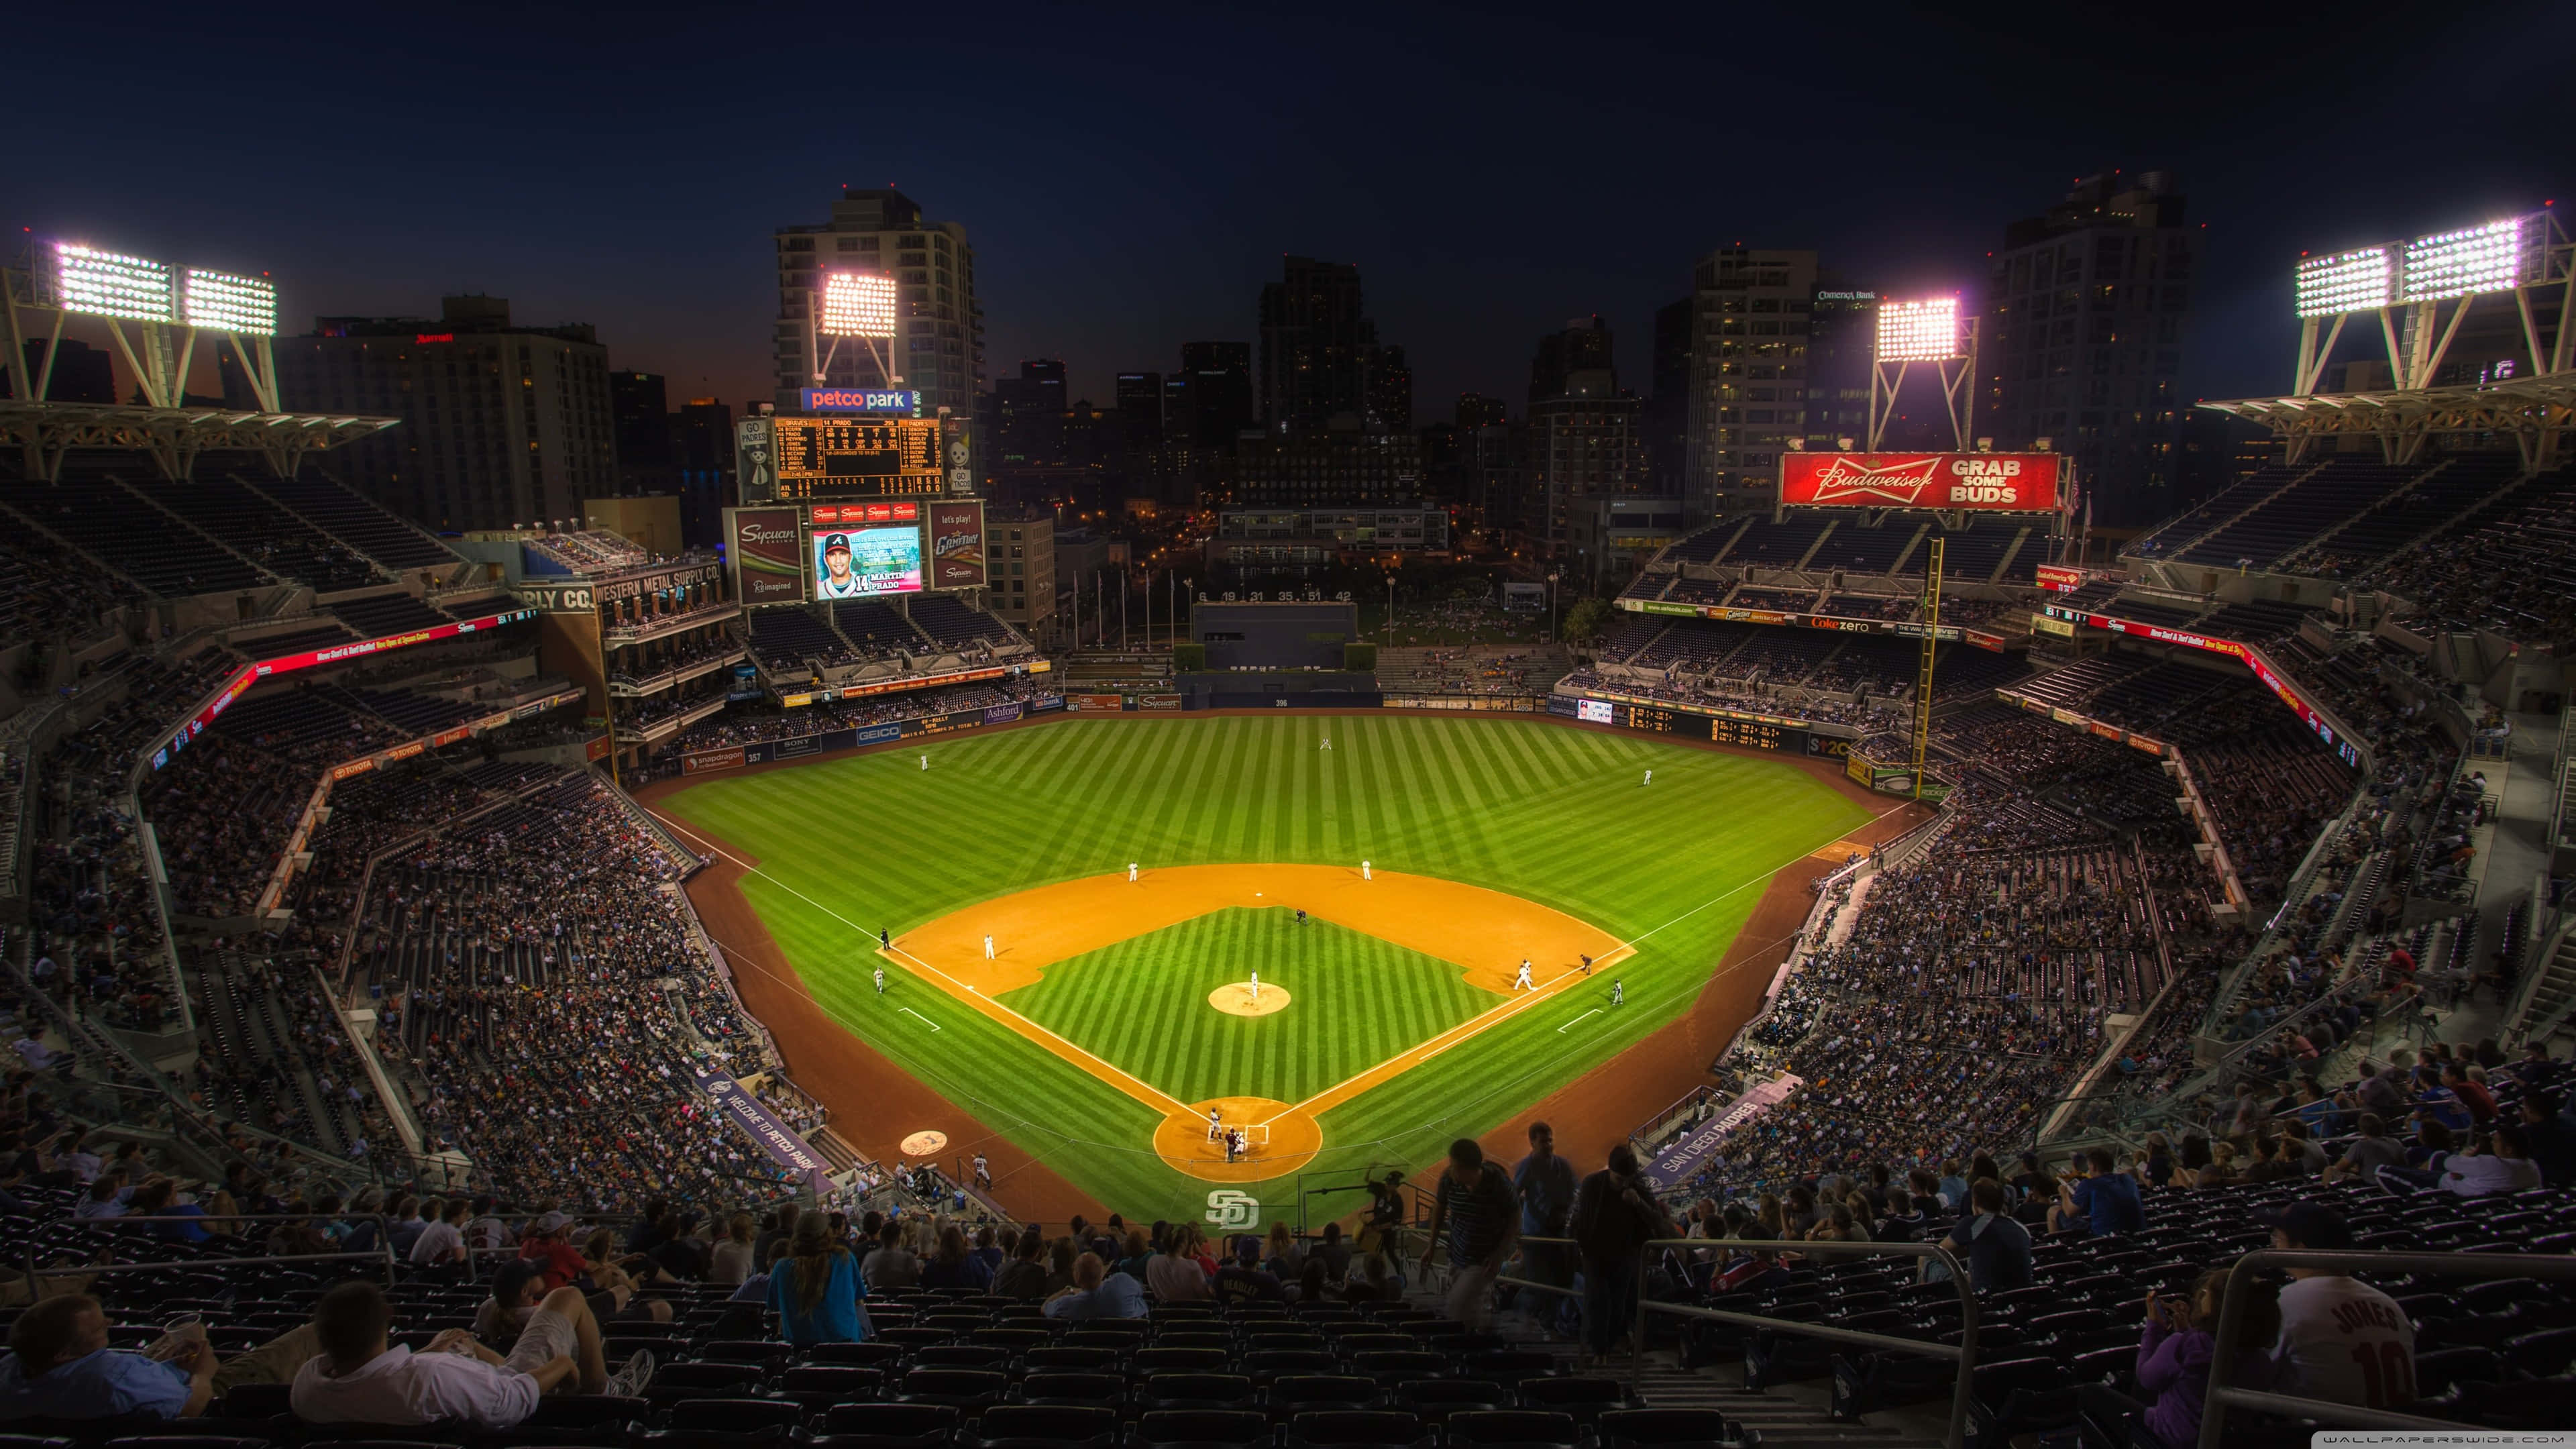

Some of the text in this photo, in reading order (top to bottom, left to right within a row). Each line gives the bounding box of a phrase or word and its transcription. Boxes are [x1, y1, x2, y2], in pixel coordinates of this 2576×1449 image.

[1856, 291, 1876, 299] Bank
[811, 390, 863, 409] petco
[866, 392, 904, 410] park
[746, 423, 759, 432] GO
[742, 433, 766, 443] PADRES
[1952, 460, 2021, 476] GRAB
[957, 472, 966, 480] GO
[1817, 468, 1933, 488] Budweiser
[1962, 477, 2006, 486] SOME
[1950, 486, 2017, 503] BUDS
[942, 515, 971, 525] let's play!
[741, 524, 796, 545] Sycuan
[871, 572, 905, 581] MARTIN
[946, 568, 971, 578] Sycuan
[595, 566, 720, 602] WESTERN METAL SUPPLY CO.
[753, 581, 791, 593] Reimagined
[856, 576, 900, 592] 14 PRADO
[1199, 592, 1351, 601] 6 19 31 35 51 42
[1648, 604, 1693, 613] www.usfoods.com
[1811, 617, 1868, 632] Coke zero
[1143, 697, 1177, 708] Sycuan
[987, 705, 1019, 718] Ashford
[859, 726, 900, 741] GEICO
[784, 739, 809, 747] SONY
[2137, 740, 2157, 753] TOYOTA
[398, 744, 422, 757] TOYOTA
[698, 751, 743, 764] snapdragon
[748, 753, 761, 763] 357
[345, 760, 372, 774] TOYOTA
[728, 1094, 817, 1171] WELCOME TO PETCO PARK
[1662, 1102, 1758, 1173] SAN DIEGO PADRES
[1205, 1189, 1259, 1230] SD
[2330, 1299, 2399, 1335] JONES
[2350, 1340, 2414, 1407] 10
